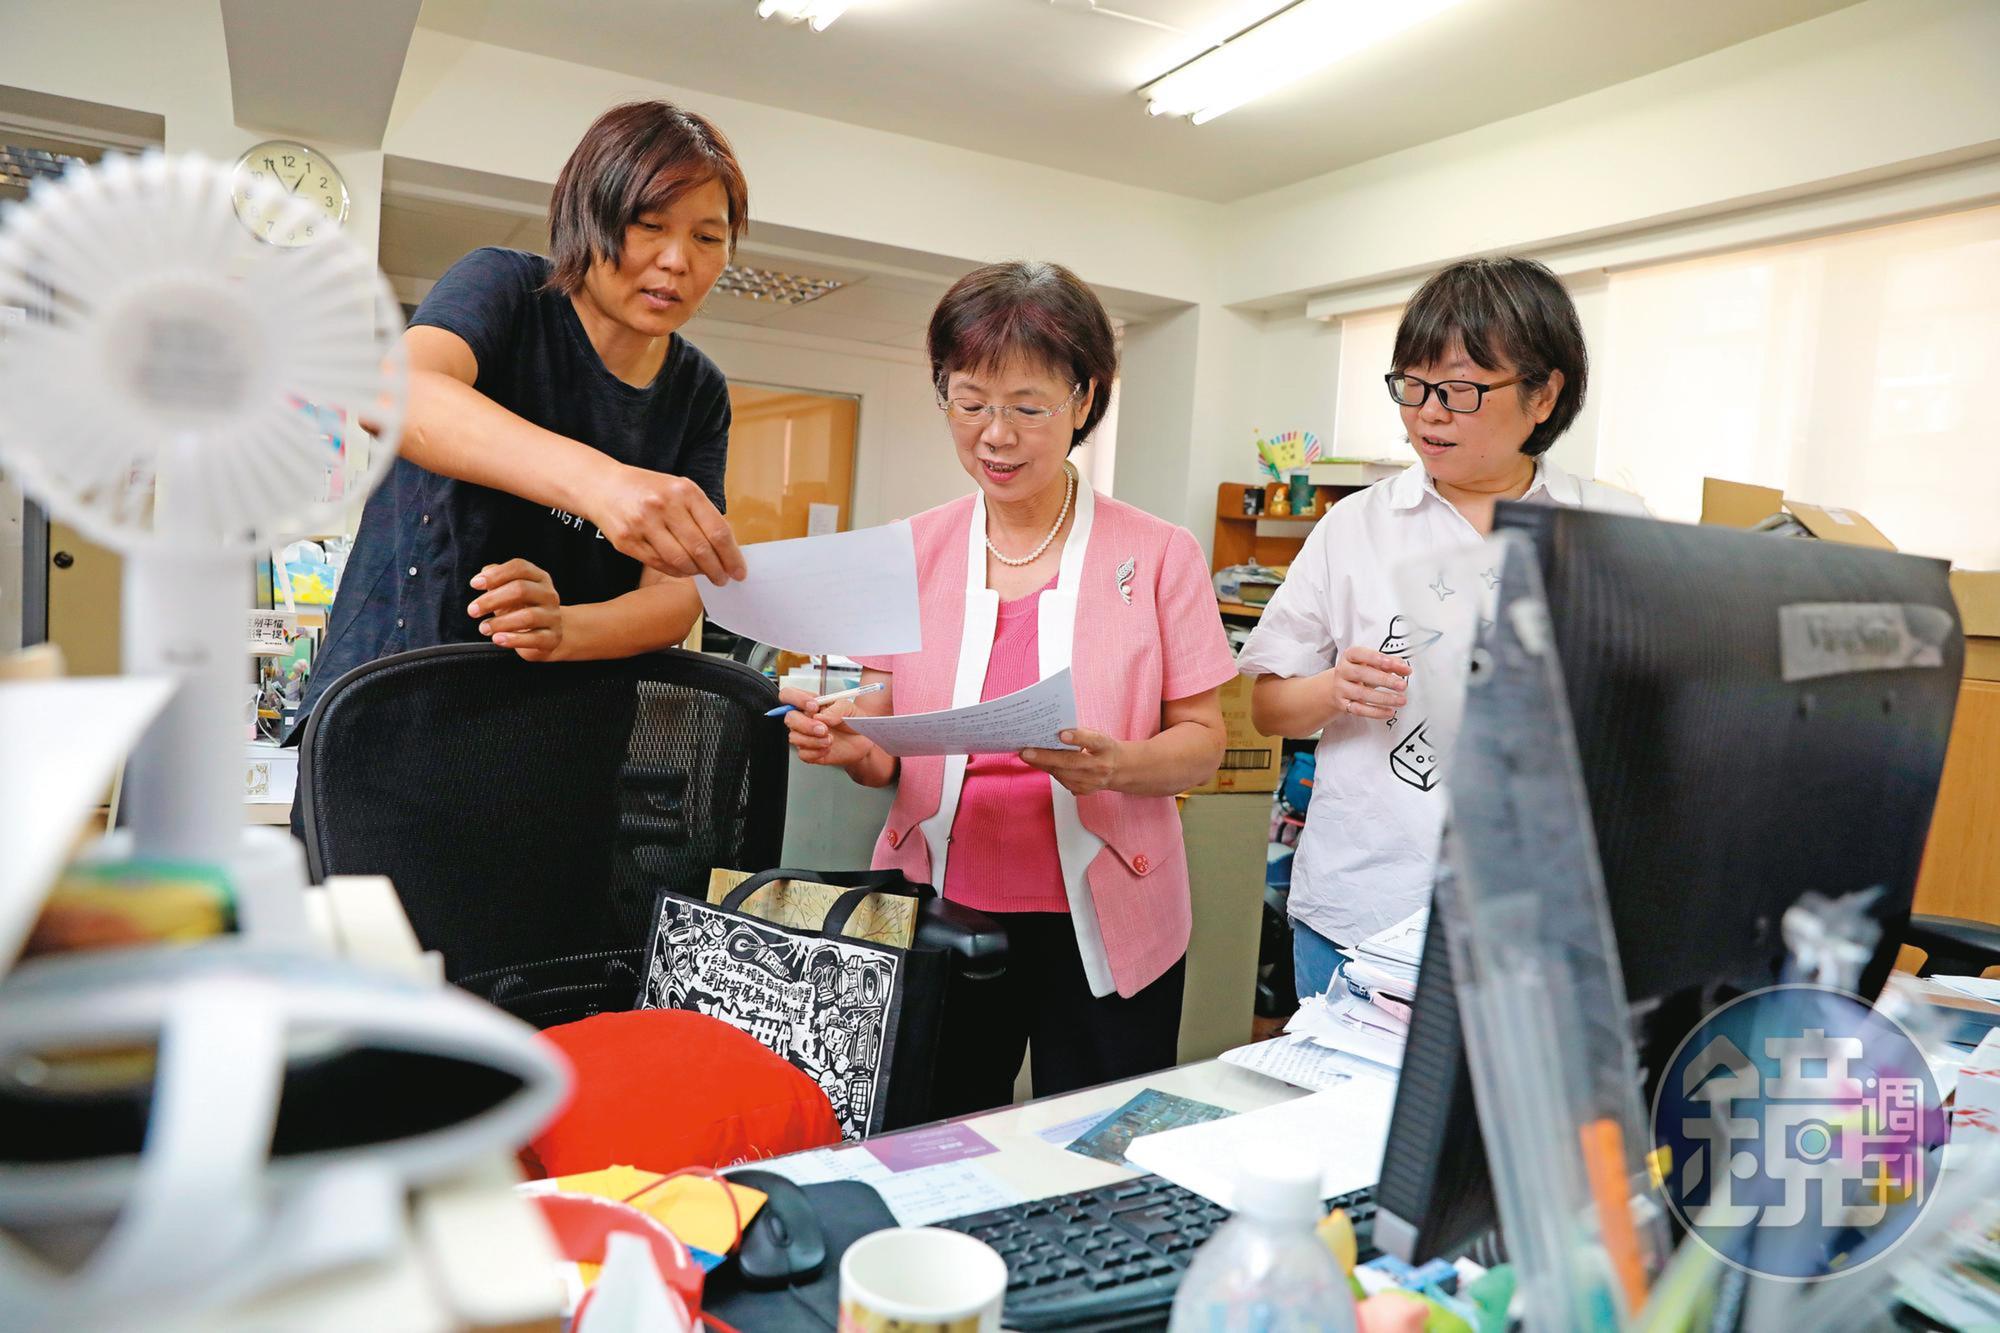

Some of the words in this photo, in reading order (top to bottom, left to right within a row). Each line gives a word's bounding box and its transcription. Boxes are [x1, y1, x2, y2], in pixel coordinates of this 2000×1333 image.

[281, 156, 296, 168] 12
[306, 162, 311, 174] 1
[320, 177, 328, 189] 2
[326, 196, 334, 208] 3
[267, 220, 275, 233] 7
[306, 226, 314, 237] 5
